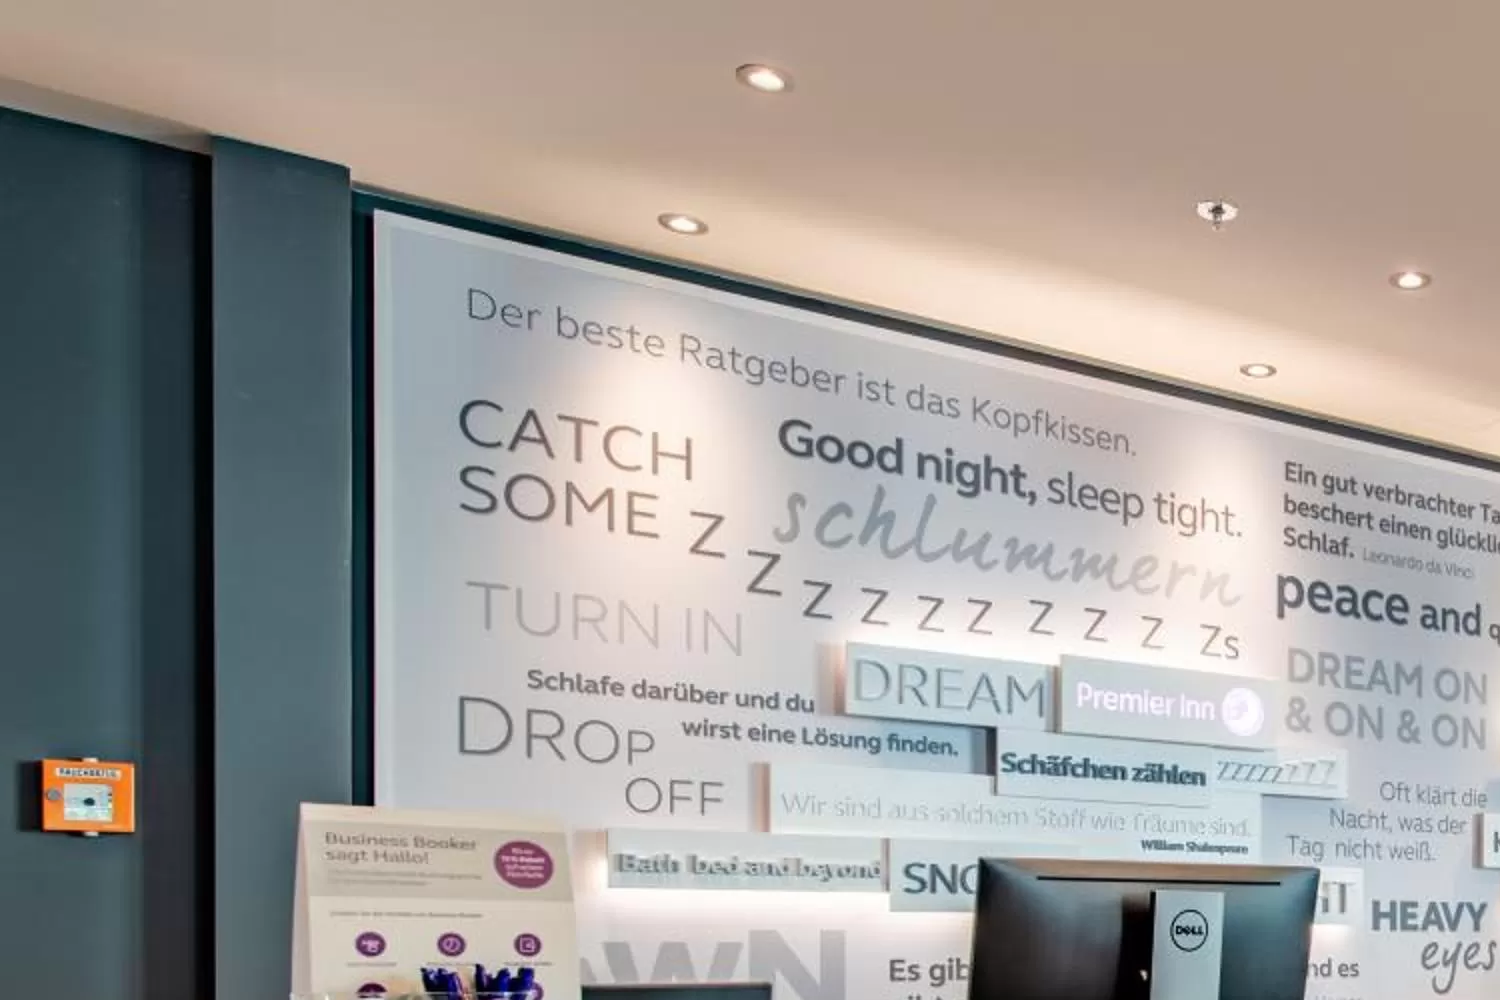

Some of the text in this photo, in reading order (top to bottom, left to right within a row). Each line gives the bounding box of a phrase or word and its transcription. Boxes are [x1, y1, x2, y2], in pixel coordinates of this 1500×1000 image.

[467, 287, 1137, 457] Der beste Ratgeber ist das Kopfkissen.
[459, 400, 693, 481] CATCH
[778, 419, 1243, 538] Good night, sleep tight.
[1284, 461, 1317, 487] Ein
[1322, 472, 1359, 497] gut
[1363, 480, 1476, 520] verbrachter
[459, 466, 660, 539] SOME
[1283, 493, 1374, 530] beschert
[1379, 515, 1432, 541] einen
[772, 484, 1242, 608] schlummern
[1283, 526, 1355, 559] Schlaf.
[466, 580, 743, 656] TURN IN
[1276, 573, 1410, 625] peace
[1420, 603, 1482, 637] and
[527, 669, 815, 713] Schlafe darüber und du
[853, 657, 1046, 719] DREAM
[1287, 648, 1488, 705] DREAM ON
[1076, 681, 1216, 721] Premier Inn
[1285, 697, 1487, 751] & ON & ON
[458, 696, 656, 766] DROP
[681, 717, 959, 757] wirst eine Lösung finden.
[1000, 751, 1126, 782] Schäfchen
[1131, 754, 1207, 787] zählen
[625, 777, 725, 816] OFF
[781, 792, 827, 816] Wir
[835, 797, 882, 820] sind
[888, 803, 928, 822] aus
[1035, 808, 1087, 830] Stoff
[1092, 811, 1126, 832] wie
[1379, 782, 1488, 808] Oft klärt die
[325, 832, 409, 848] Business
[1329, 808, 1468, 834] Nacht, was der
[1286, 835, 1436, 862] Tag nicht weiß.
[1371, 900, 1488, 932] HEAVY
[889, 957, 969, 988] Es gib
[1308, 957, 1360, 978] nd es
[1421, 940, 1497, 994] eyes
